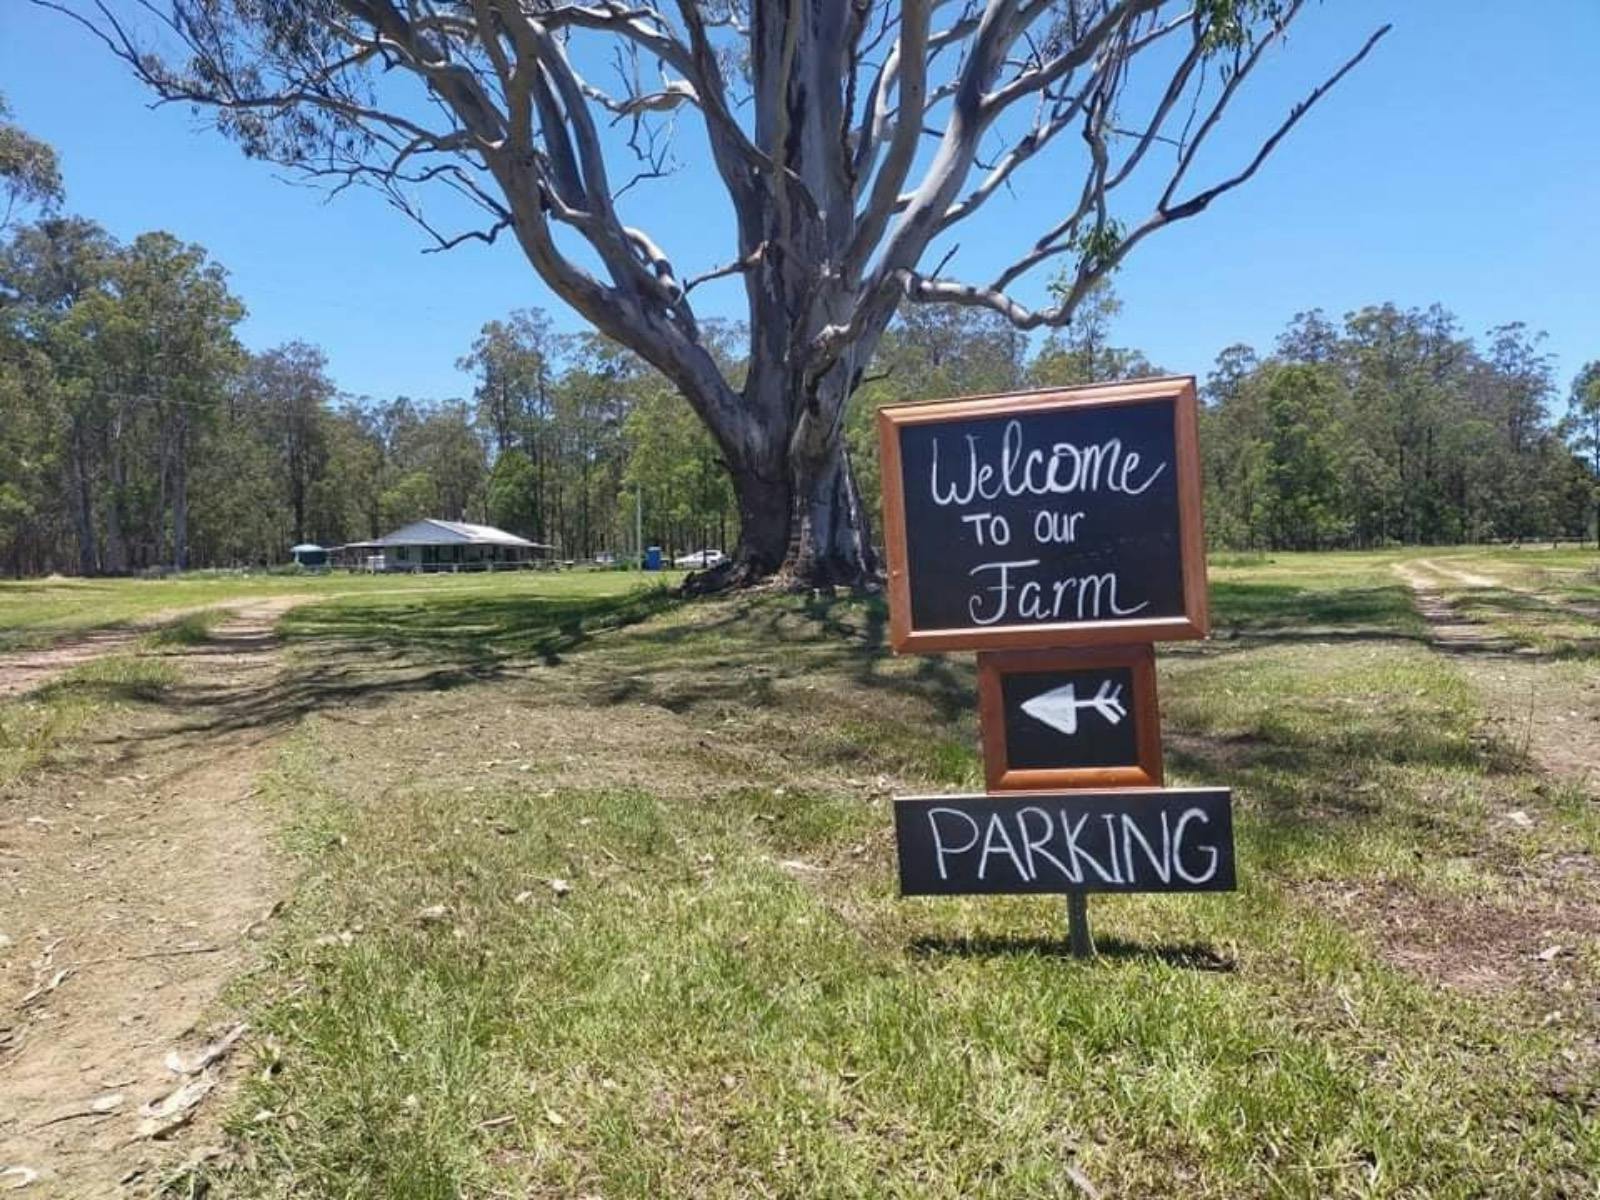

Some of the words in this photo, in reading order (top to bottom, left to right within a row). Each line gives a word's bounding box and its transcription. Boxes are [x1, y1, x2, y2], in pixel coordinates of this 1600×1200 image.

[931, 419, 1166, 506] Welcome
[969, 559, 1150, 625] Farm
[928, 807, 1217, 883] PARKING
